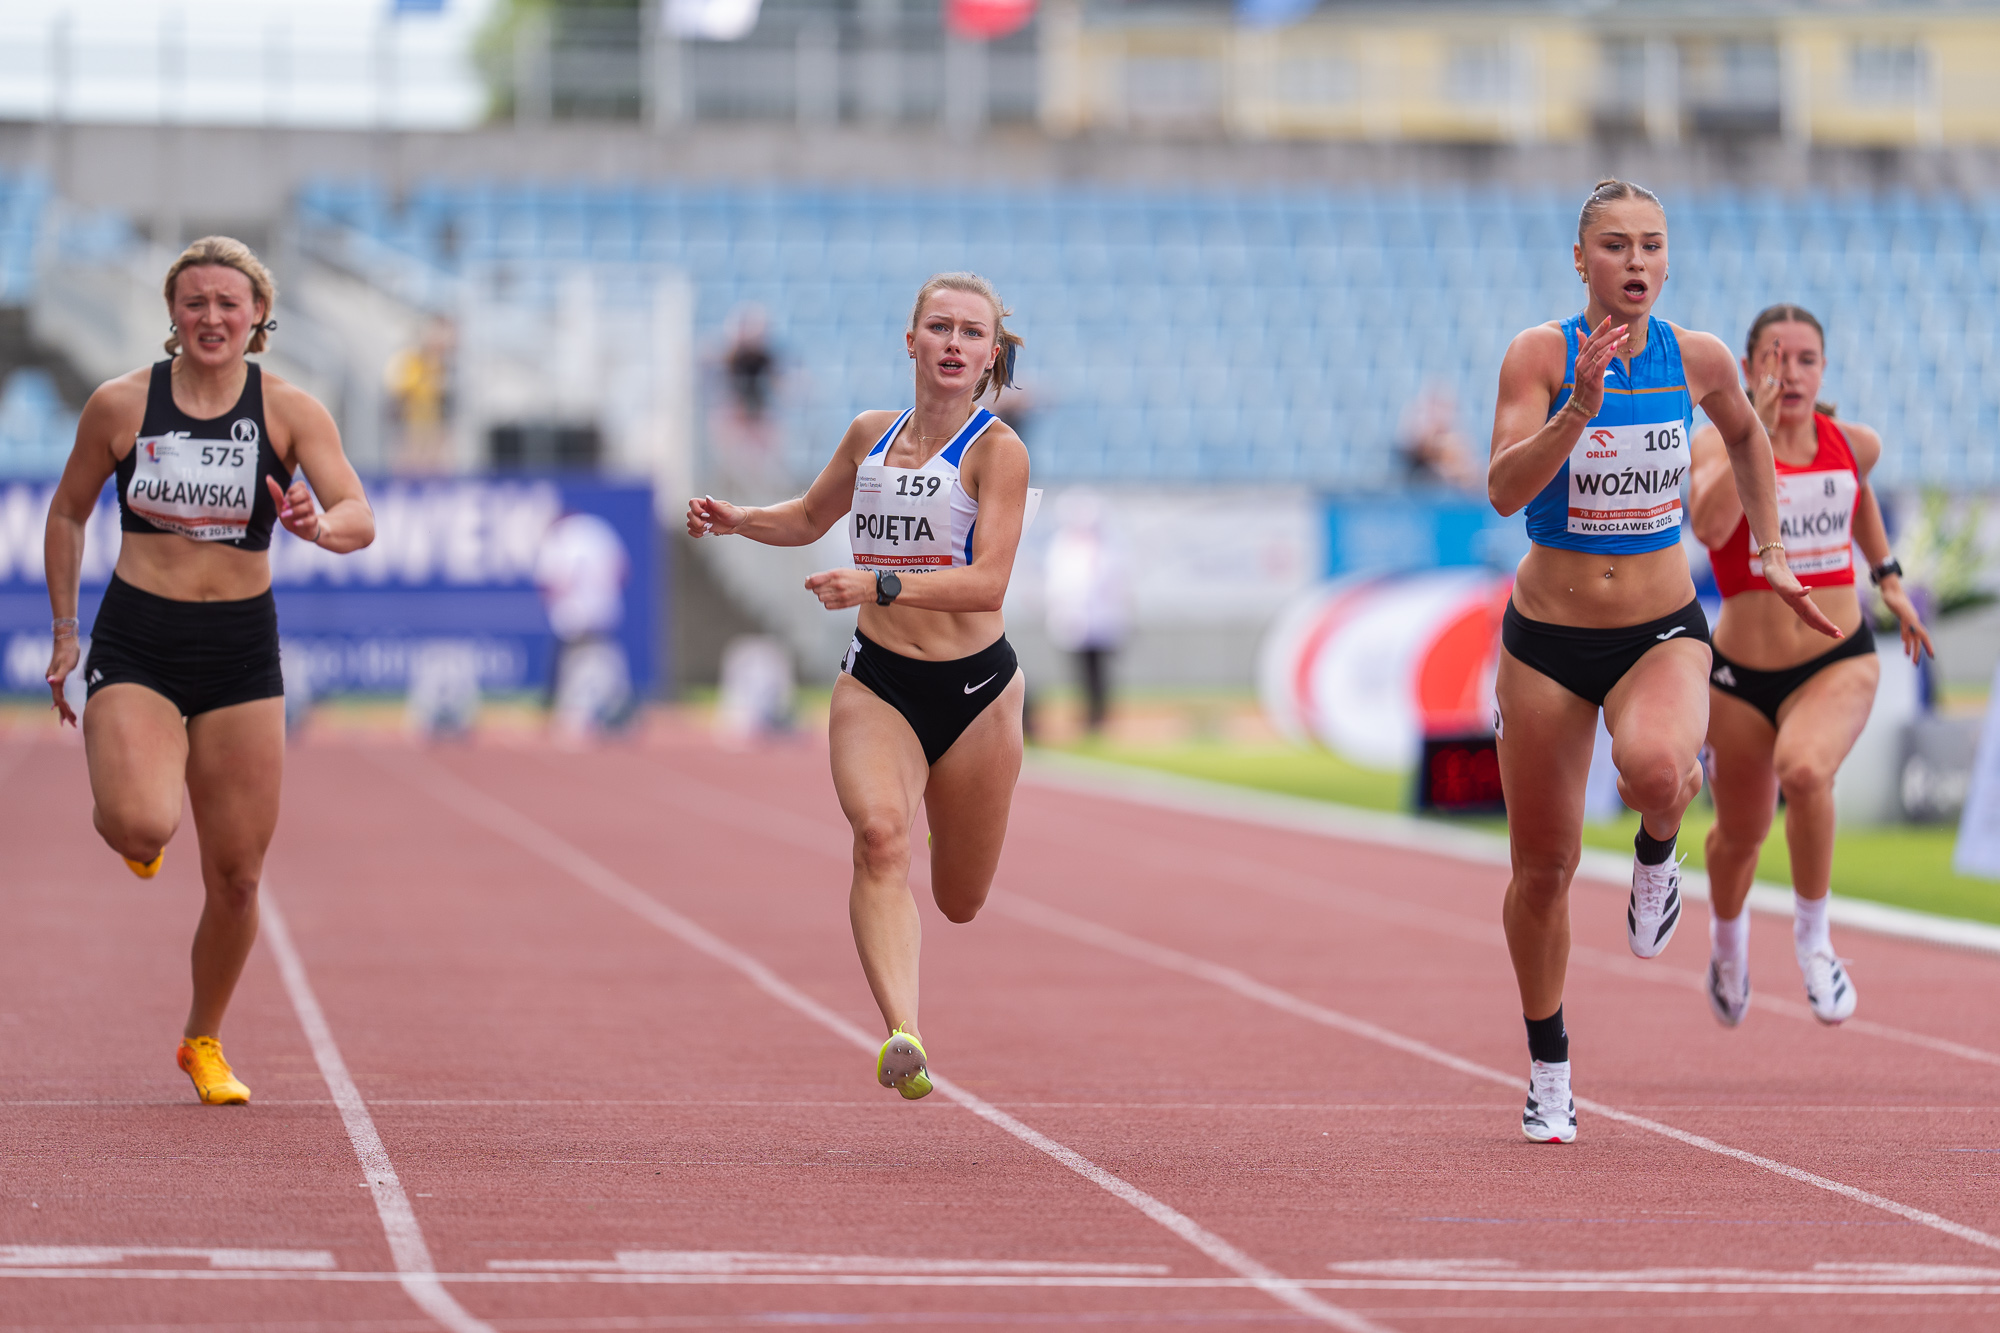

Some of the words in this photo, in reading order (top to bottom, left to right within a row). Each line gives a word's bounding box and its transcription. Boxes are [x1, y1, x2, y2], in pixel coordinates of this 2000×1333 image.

[1644, 428, 1681, 451] 105
[201, 446, 244, 467] 575
[1586, 450, 1618, 459] ORLEN
[896, 474, 941, 497] 159
[1575, 466, 1686, 496] WOŹNIAK
[133, 479, 247, 509] PUŁAWSKA
[1580, 510, 1590, 518] 79.
[1591, 510, 1608, 519] PZLA
[1609, 509, 1651, 518] Mistrzostwa
[1650, 505, 1665, 515] Polski
[1581, 521, 1654, 532] WŁOCŁAWEK
[1655, 515, 1673, 528] 2025
[856, 513, 935, 546] POJĘTA
